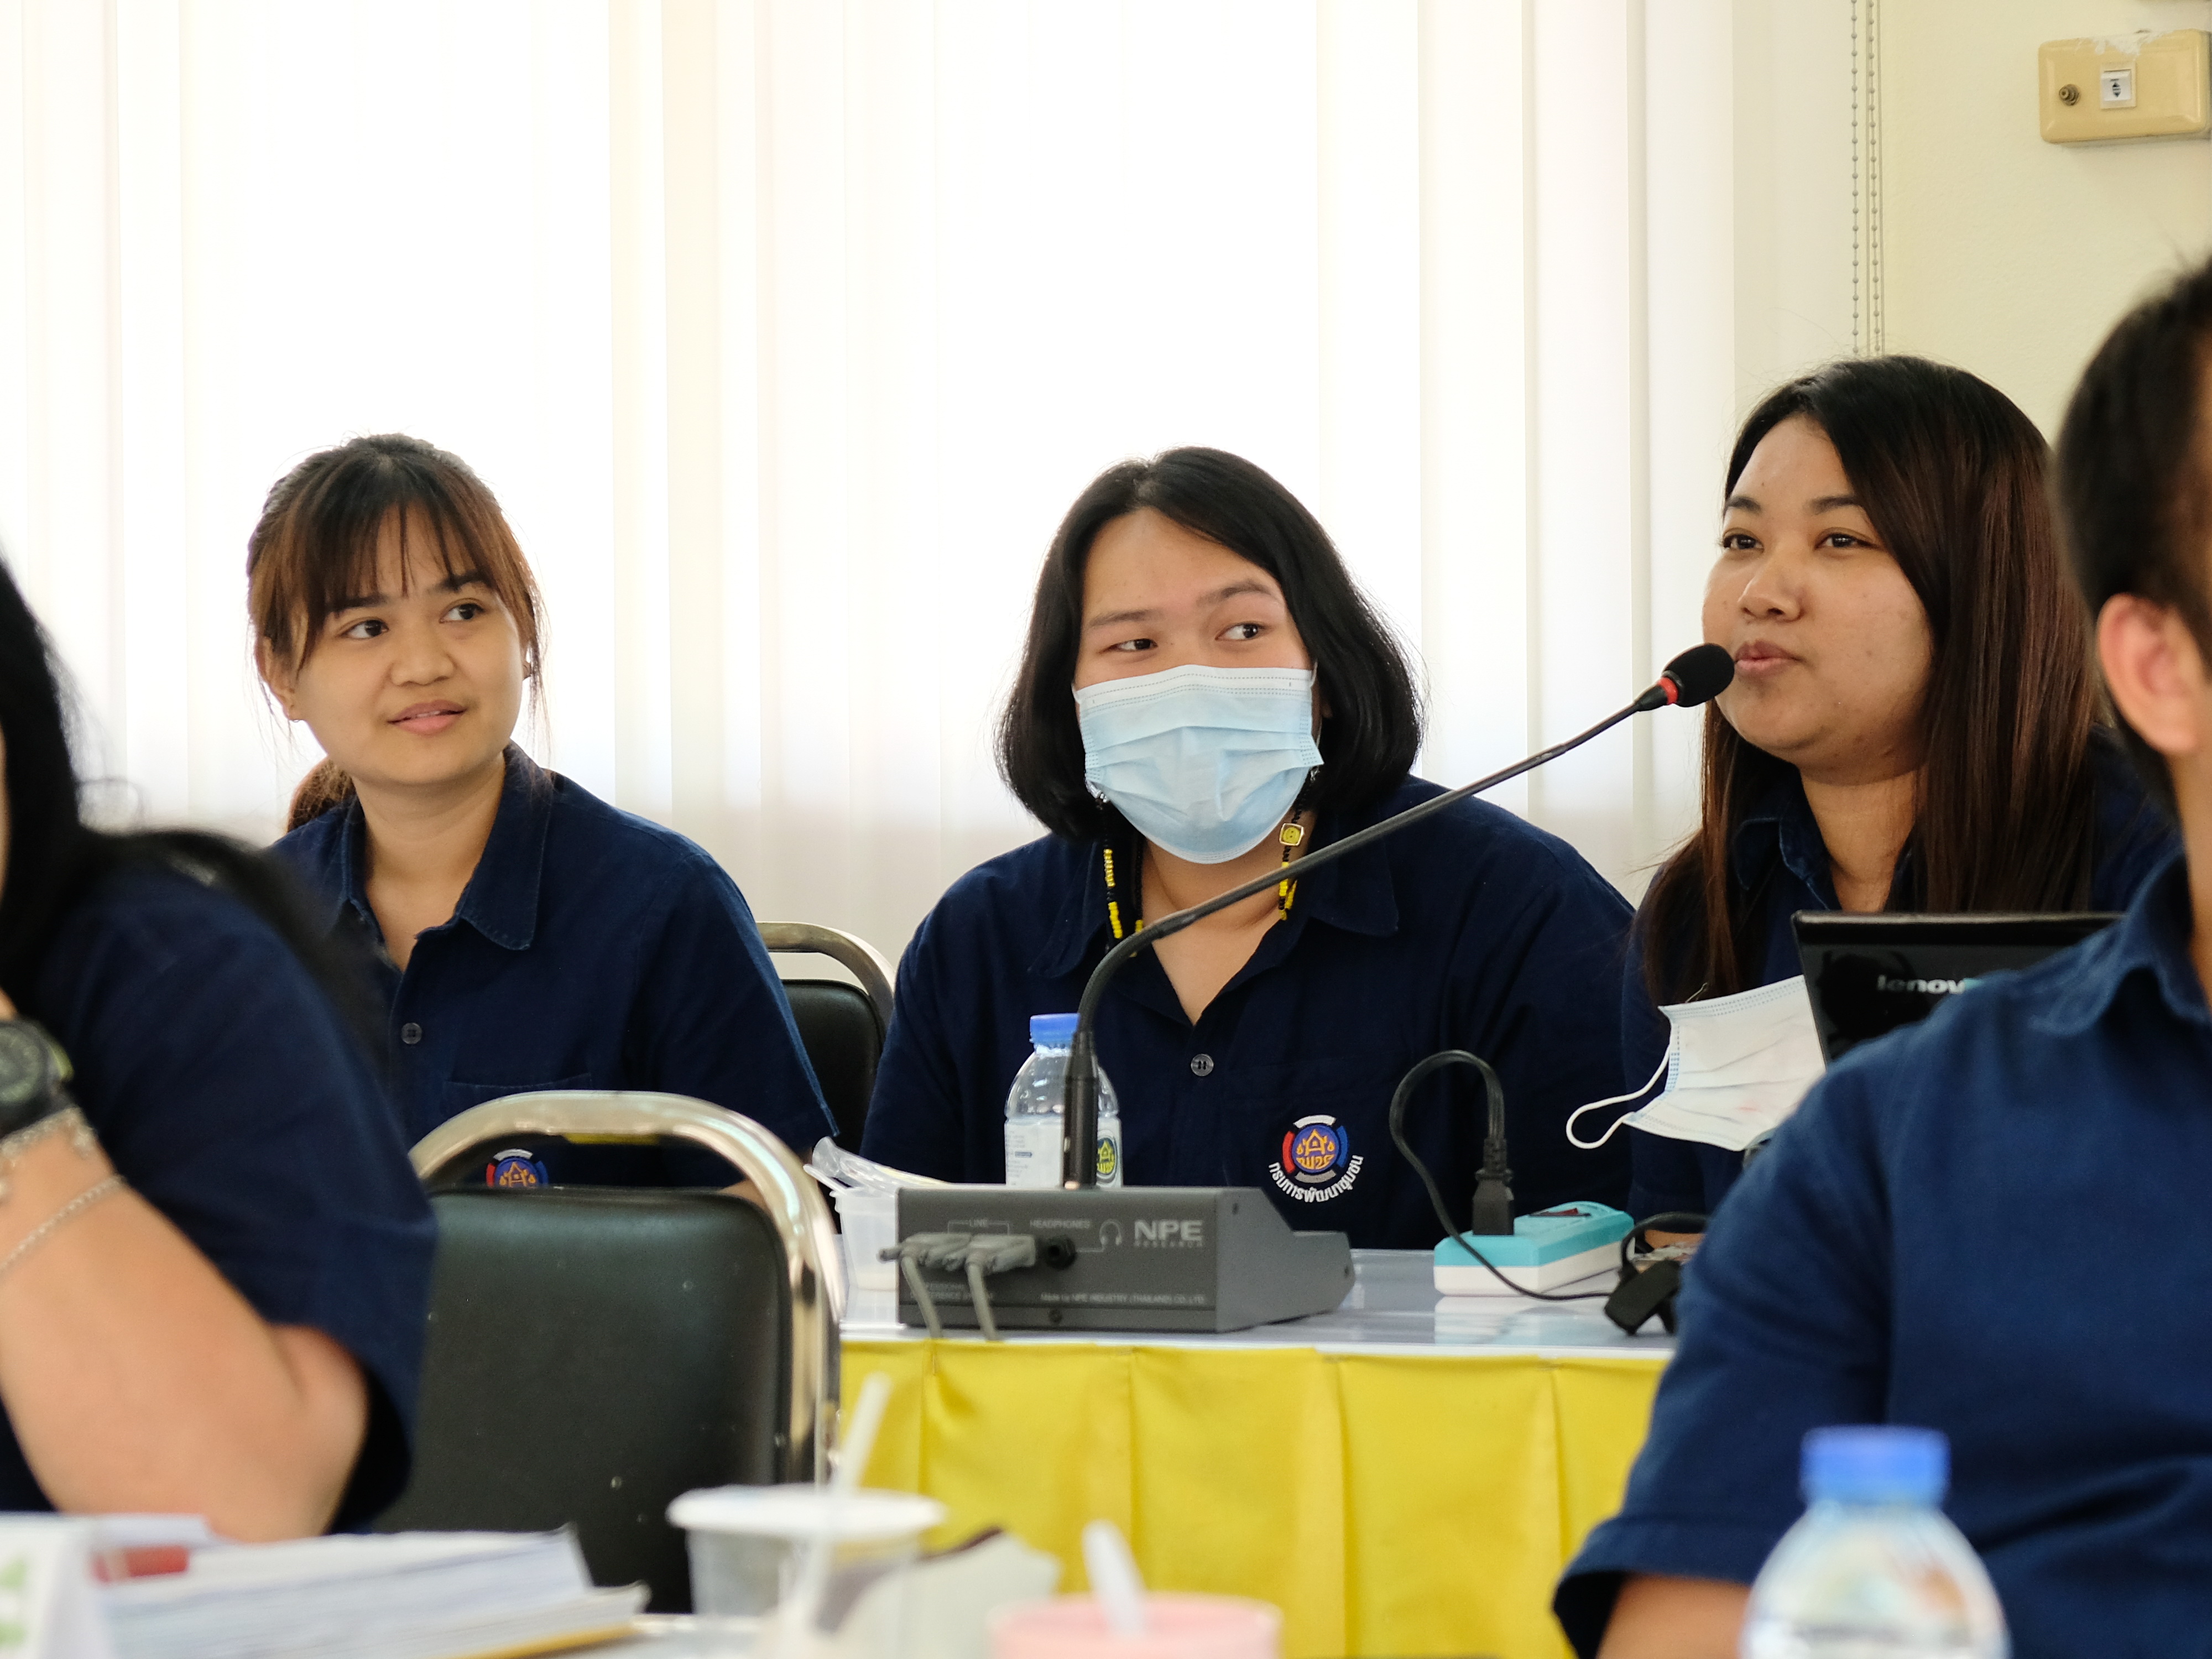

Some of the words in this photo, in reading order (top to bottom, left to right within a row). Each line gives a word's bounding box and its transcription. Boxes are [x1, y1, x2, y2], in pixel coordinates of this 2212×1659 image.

[1269, 1155, 1364, 1203] กรมการพัฒนาชุมชน
[1029, 1219, 1091, 1229] HEADPHONES
[1134, 1219, 1203, 1241] NPE
